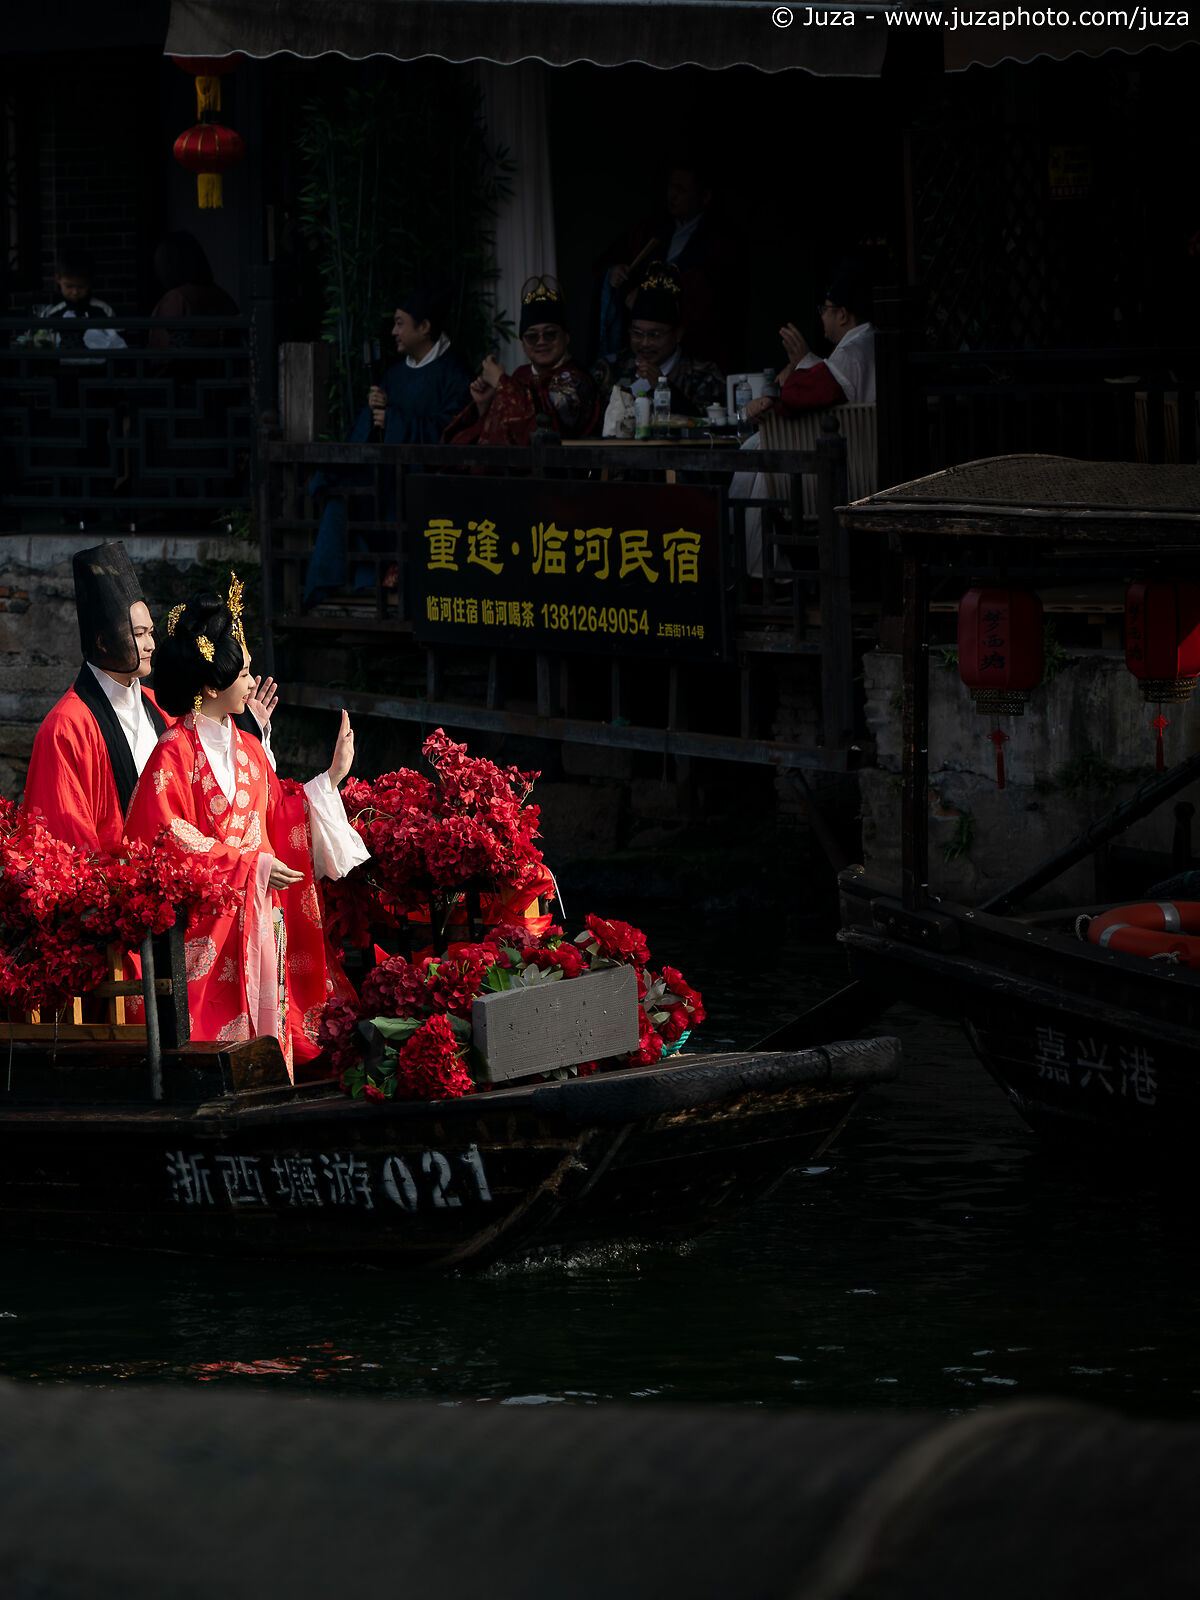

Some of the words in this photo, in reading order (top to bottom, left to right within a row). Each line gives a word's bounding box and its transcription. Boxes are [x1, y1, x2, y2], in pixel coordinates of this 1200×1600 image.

[426, 595, 479, 625] 临河住宿
[481, 599, 535, 628] 临河喝茶
[541, 603, 650, 635] 13812649054
[1035, 1024, 1158, 1104] 嘉兴港
